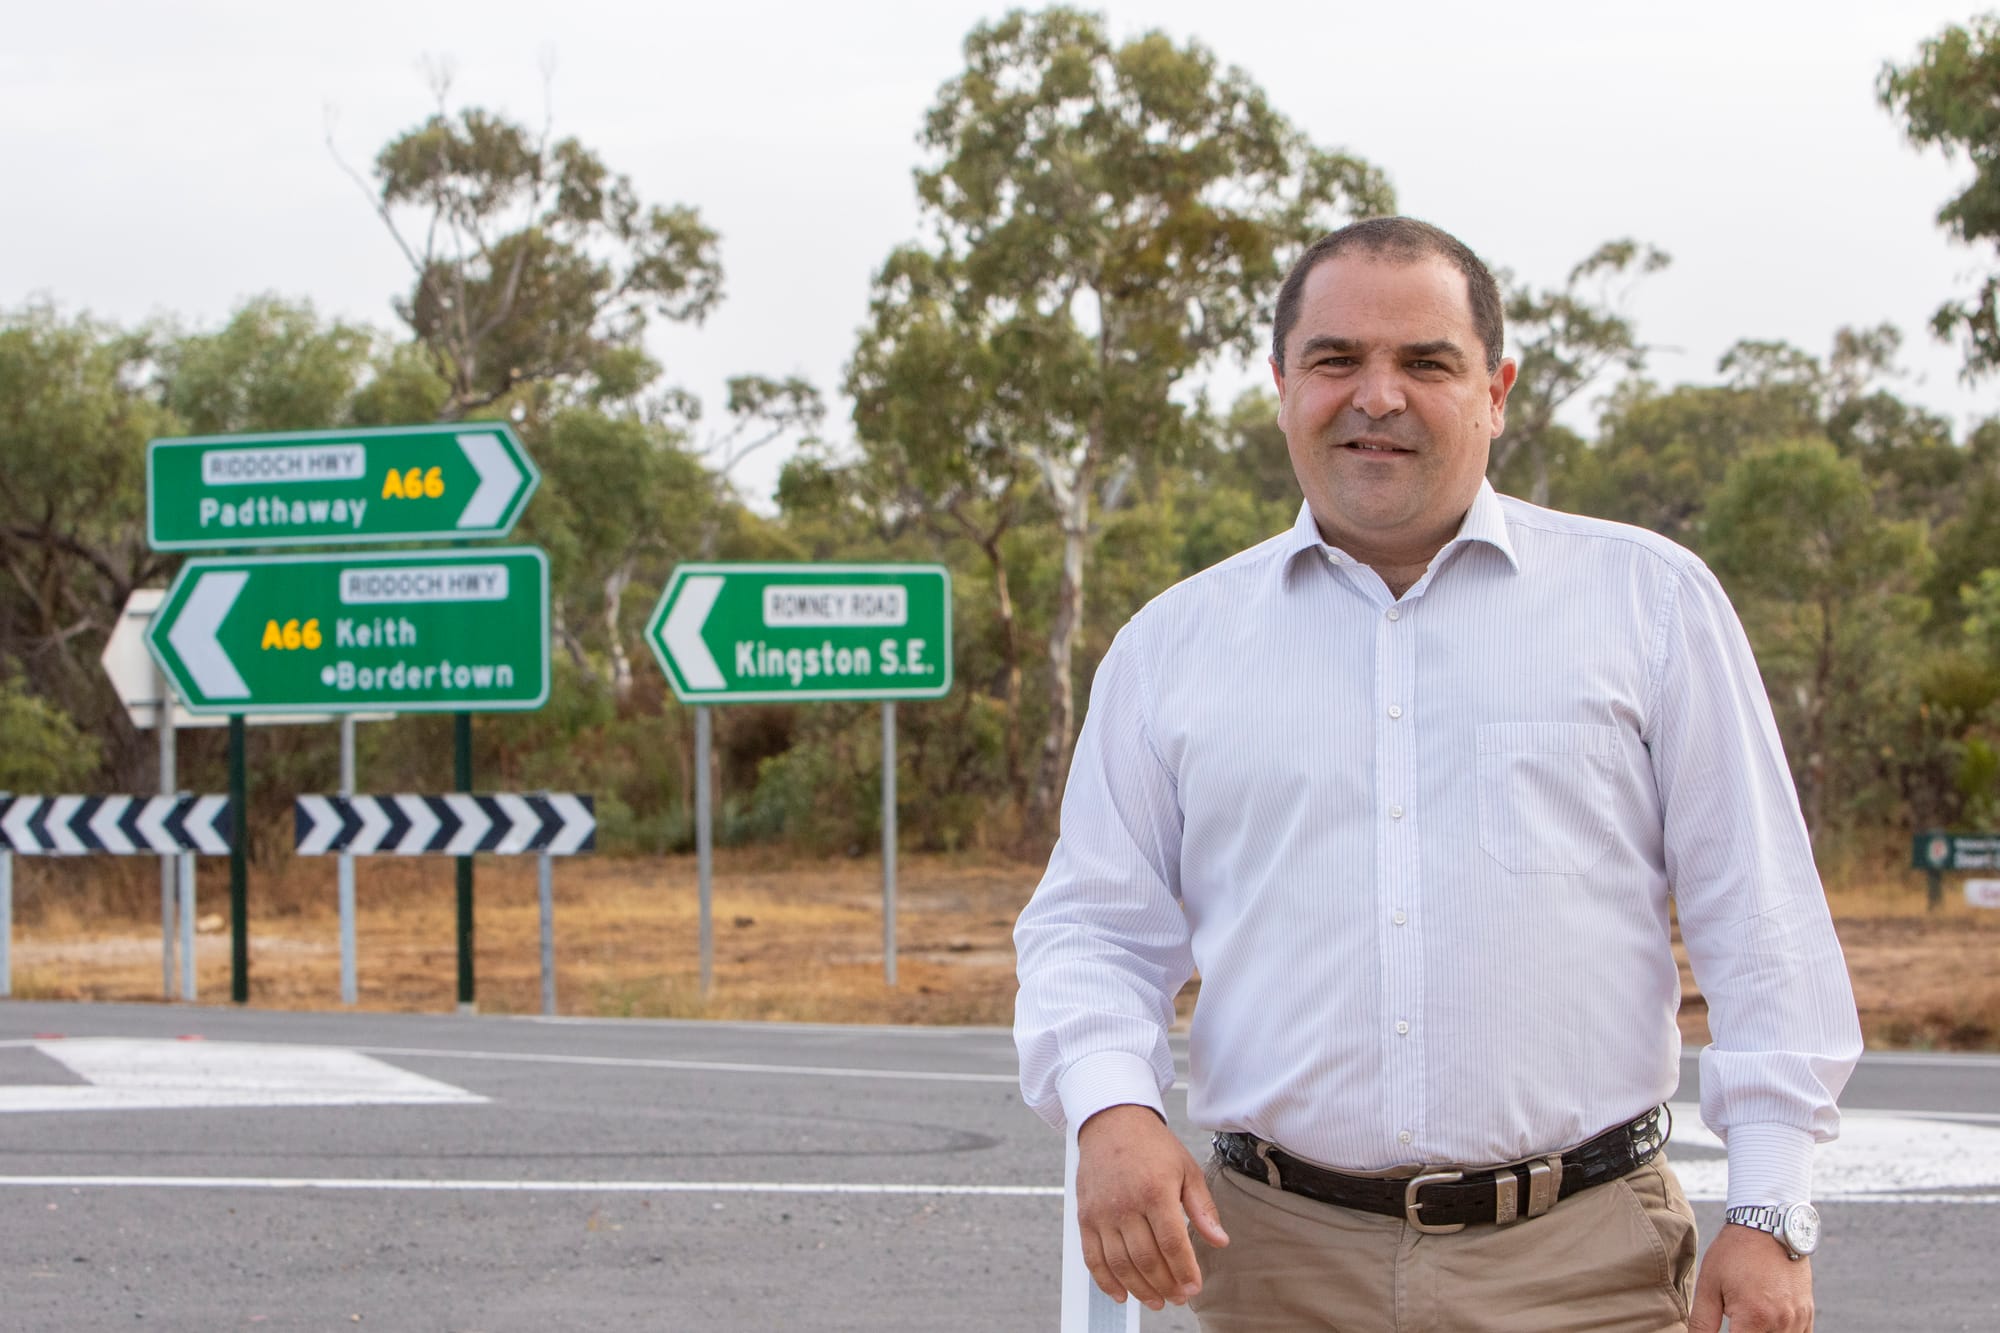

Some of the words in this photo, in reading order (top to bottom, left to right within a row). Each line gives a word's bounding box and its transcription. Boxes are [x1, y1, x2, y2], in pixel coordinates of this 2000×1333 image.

[210, 453, 301, 476] RIDDOCH
[308, 452, 356, 473] HWY
[382, 466, 445, 500] A66
[199, 496, 367, 528] Padthaway
[348, 572, 442, 596] RIDDOCH
[449, 571, 498, 594] HWY
[772, 594, 844, 619] ROMNEY
[852, 594, 898, 618] ROAD
[261, 618, 322, 650] A66
[336, 618, 417, 648] Keith
[336, 661, 513, 691] Bordertown
[735, 640, 871, 686] Kingston
[879, 638, 934, 674] S.E.
